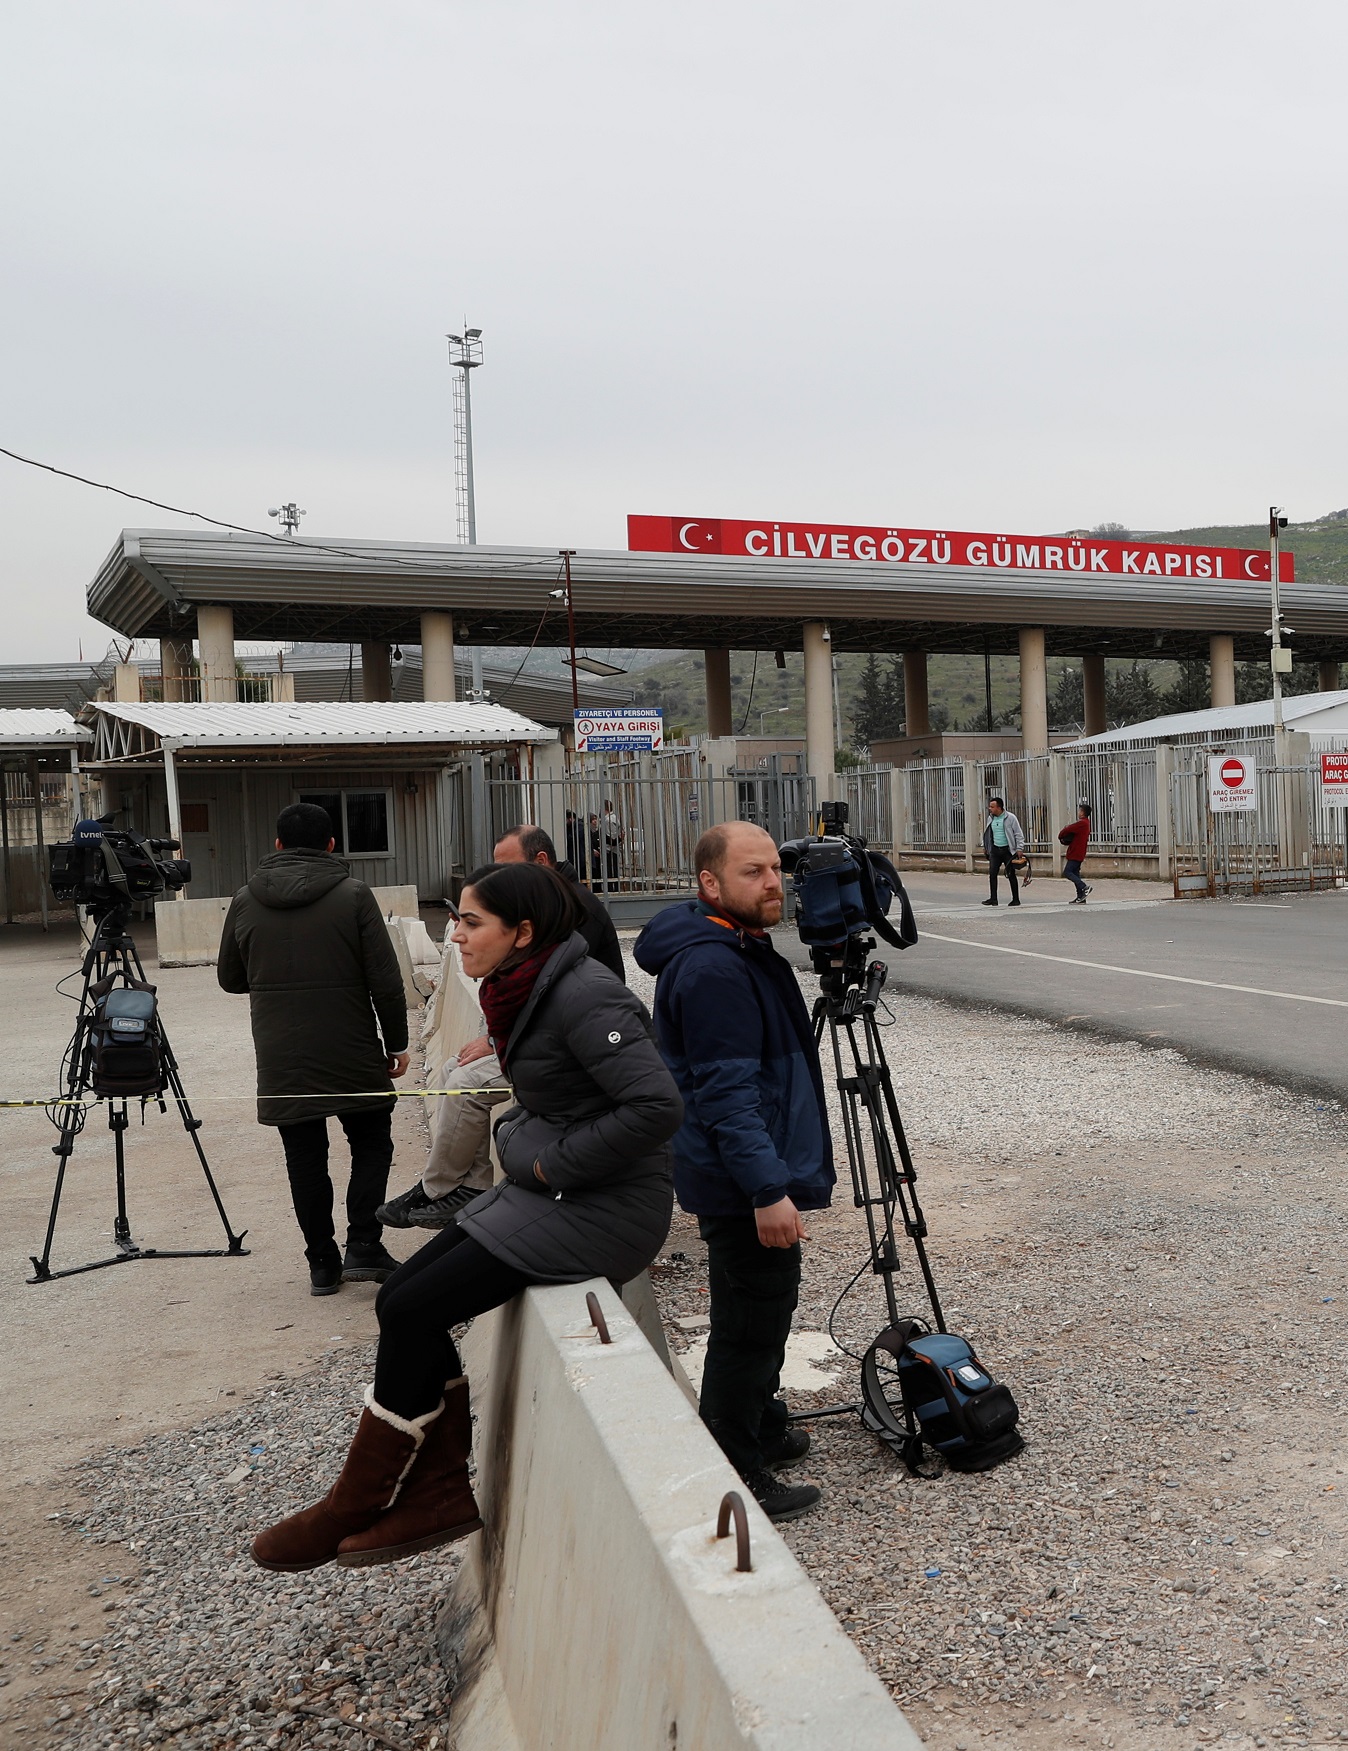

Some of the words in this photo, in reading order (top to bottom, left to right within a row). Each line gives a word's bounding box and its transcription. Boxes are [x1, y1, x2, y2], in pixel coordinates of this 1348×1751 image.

[745, 524, 951, 564] CİLVEGÖZÜ
[966, 537, 1110, 572] GÜMRÜK
[1122, 550, 1223, 578] KAPISI
[624, 709, 659, 717] PERSONEL
[596, 722, 625, 732] YAYA
[1325, 770, 1343, 782] ARAÇ
